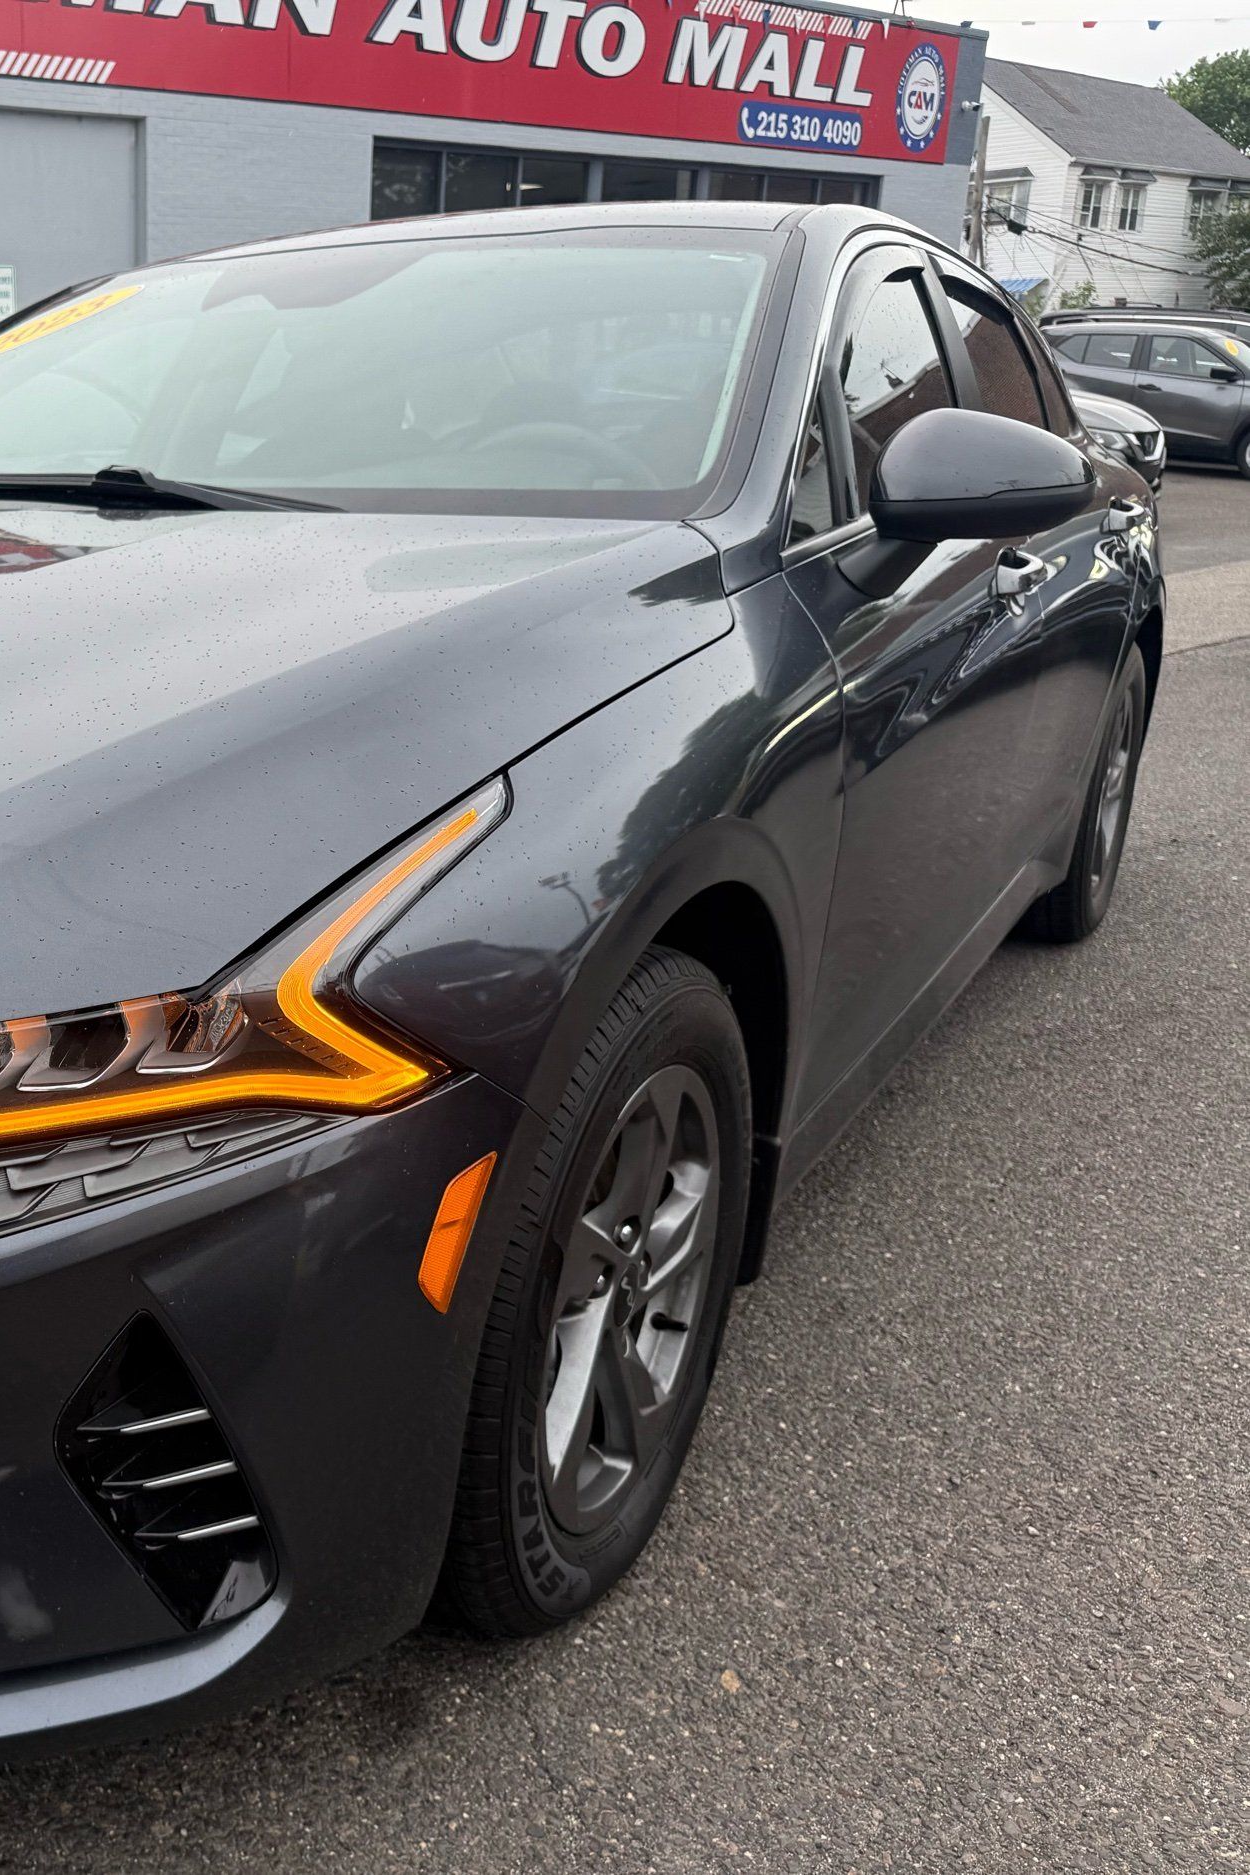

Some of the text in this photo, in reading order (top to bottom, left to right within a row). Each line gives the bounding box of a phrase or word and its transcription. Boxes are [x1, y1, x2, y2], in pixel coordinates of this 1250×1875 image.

[364, 0, 647, 77] AUTO
[663, 17, 873, 107] MALL
[907, 89, 935, 112] CAM
[755, 110, 861, 146] 215 310 4090
